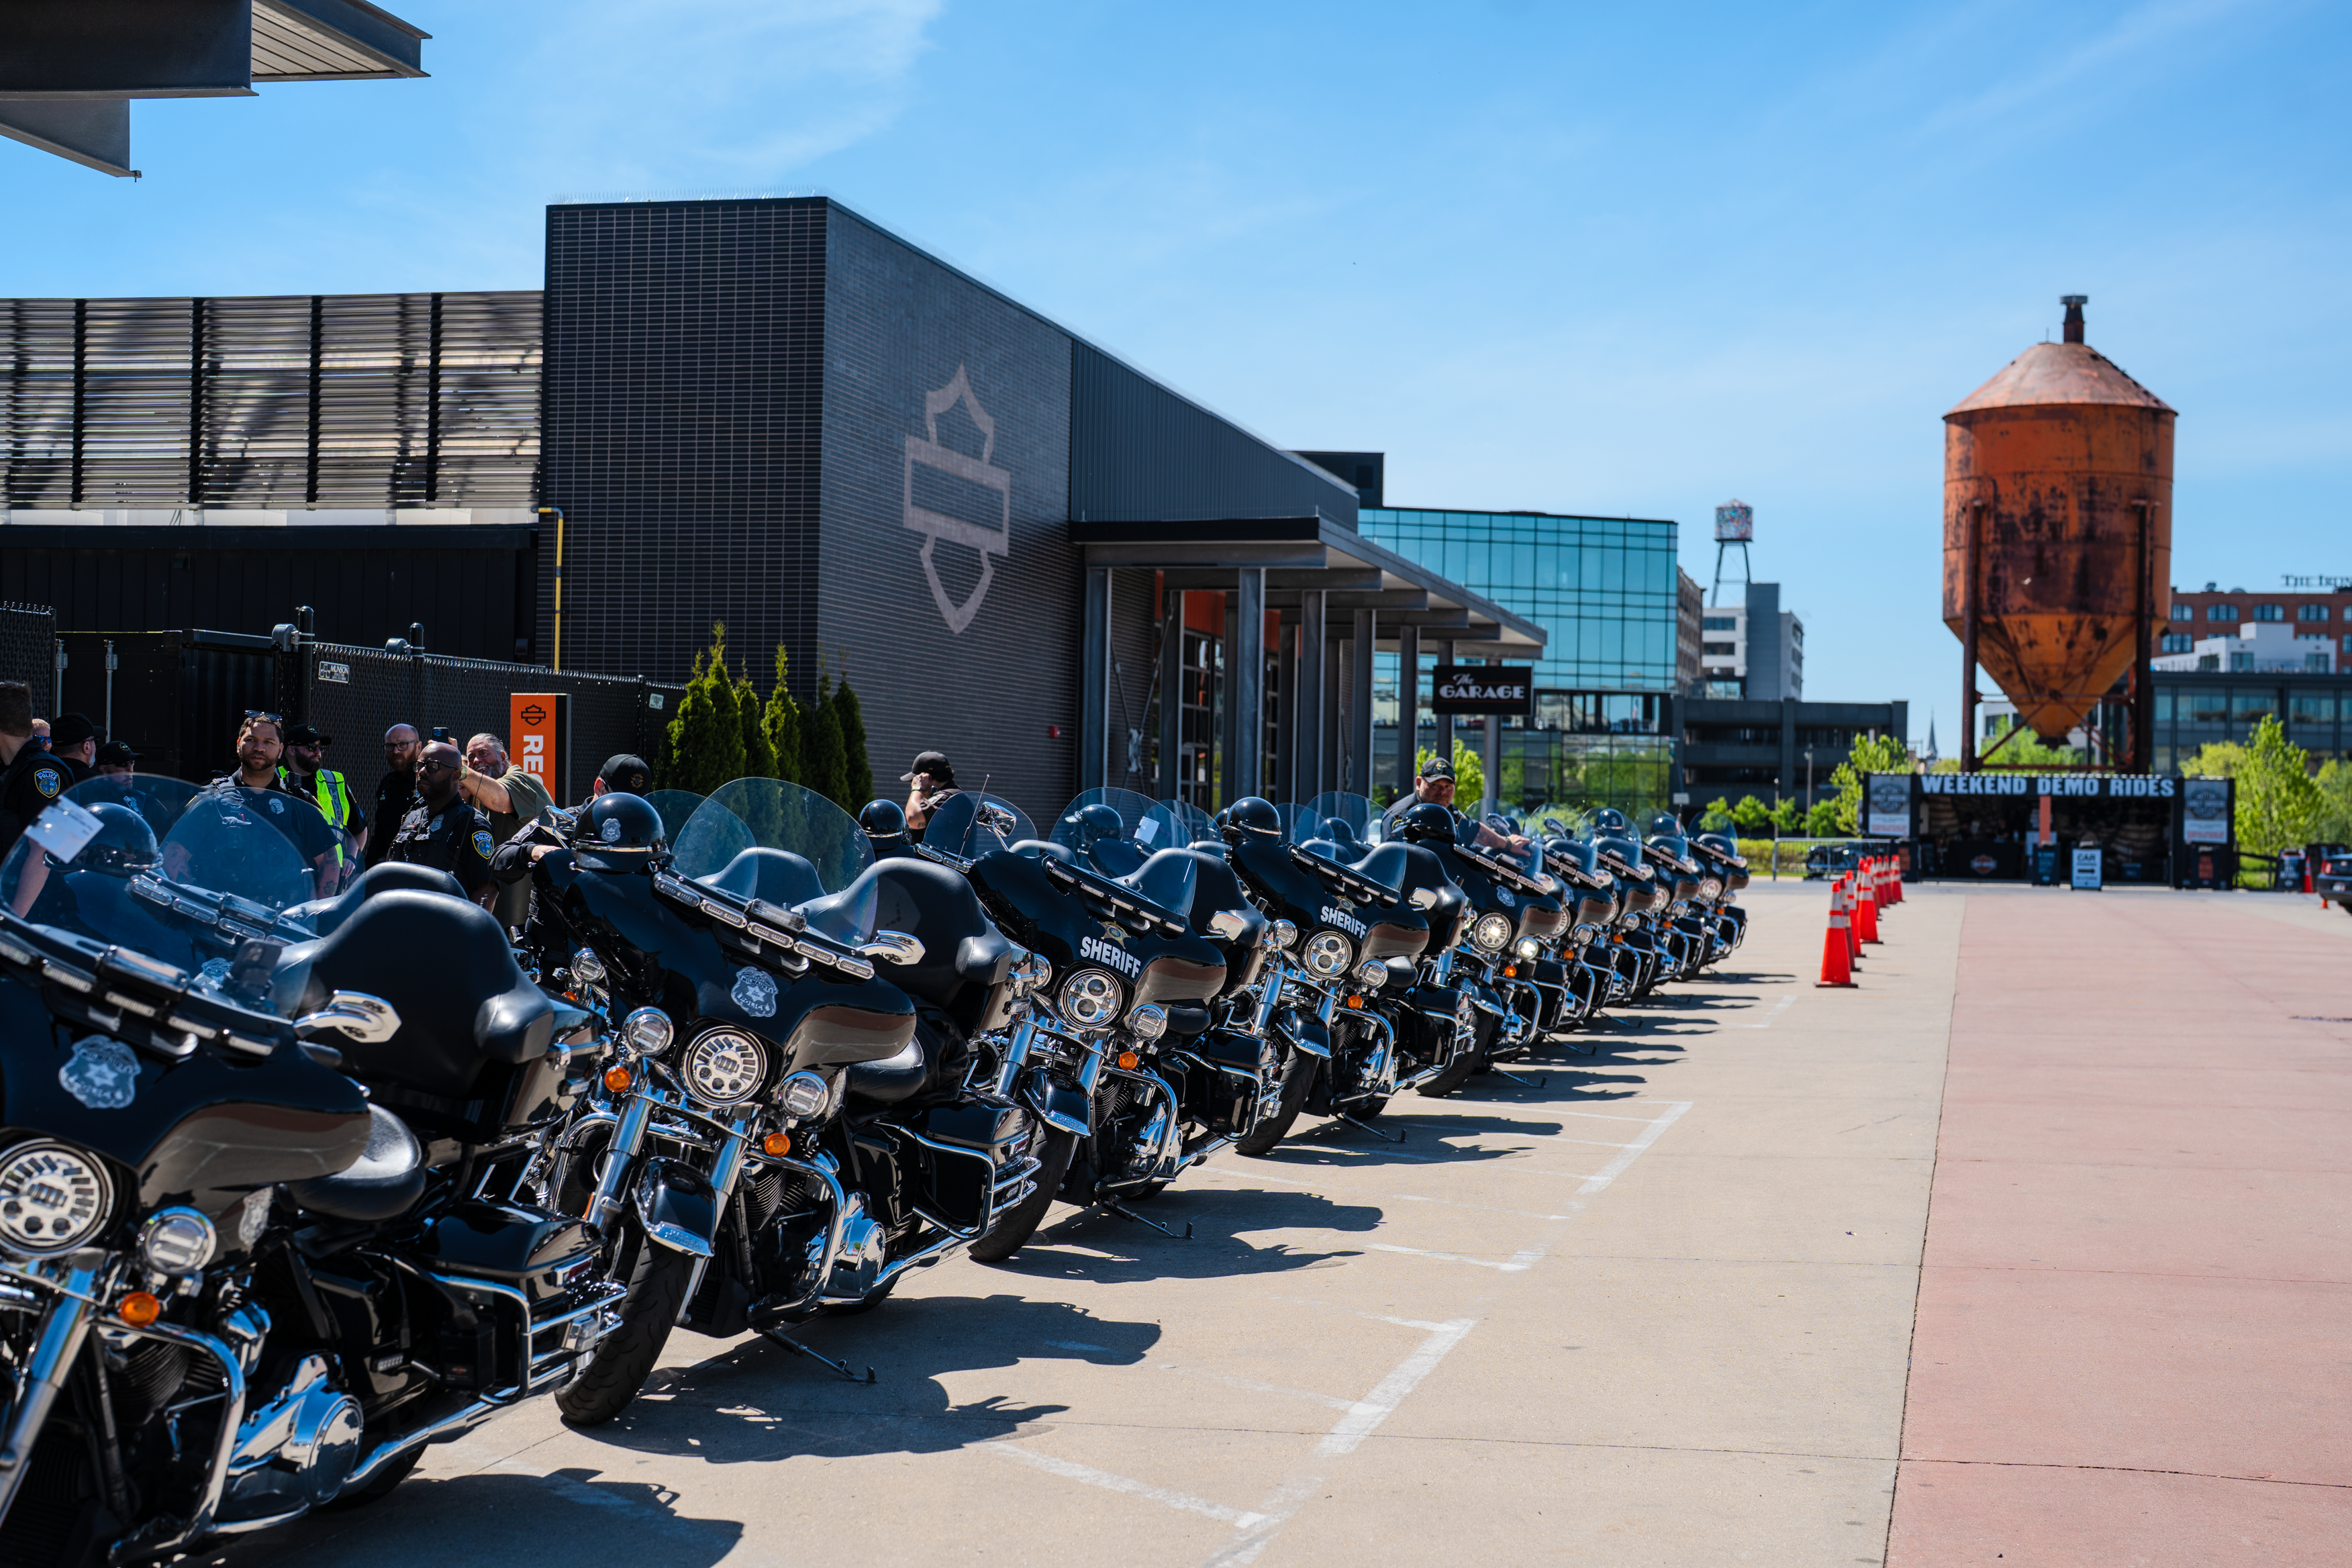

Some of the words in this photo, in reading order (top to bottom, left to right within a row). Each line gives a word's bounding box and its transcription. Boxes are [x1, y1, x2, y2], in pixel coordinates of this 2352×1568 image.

[330, 665, 349, 674] MUNSON
[1452, 673, 1475, 685] The
[1439, 685, 1525, 699] GARAGE
[1920, 775, 2027, 795] WEEKEND
[2037, 777, 2099, 796] DEMO
[2110, 779, 2175, 797] RIDES
[1320, 905, 1367, 939] SHERIFF
[1080, 936, 1141, 979] SHERIFF
[739, 995, 767, 1011] POLICE
